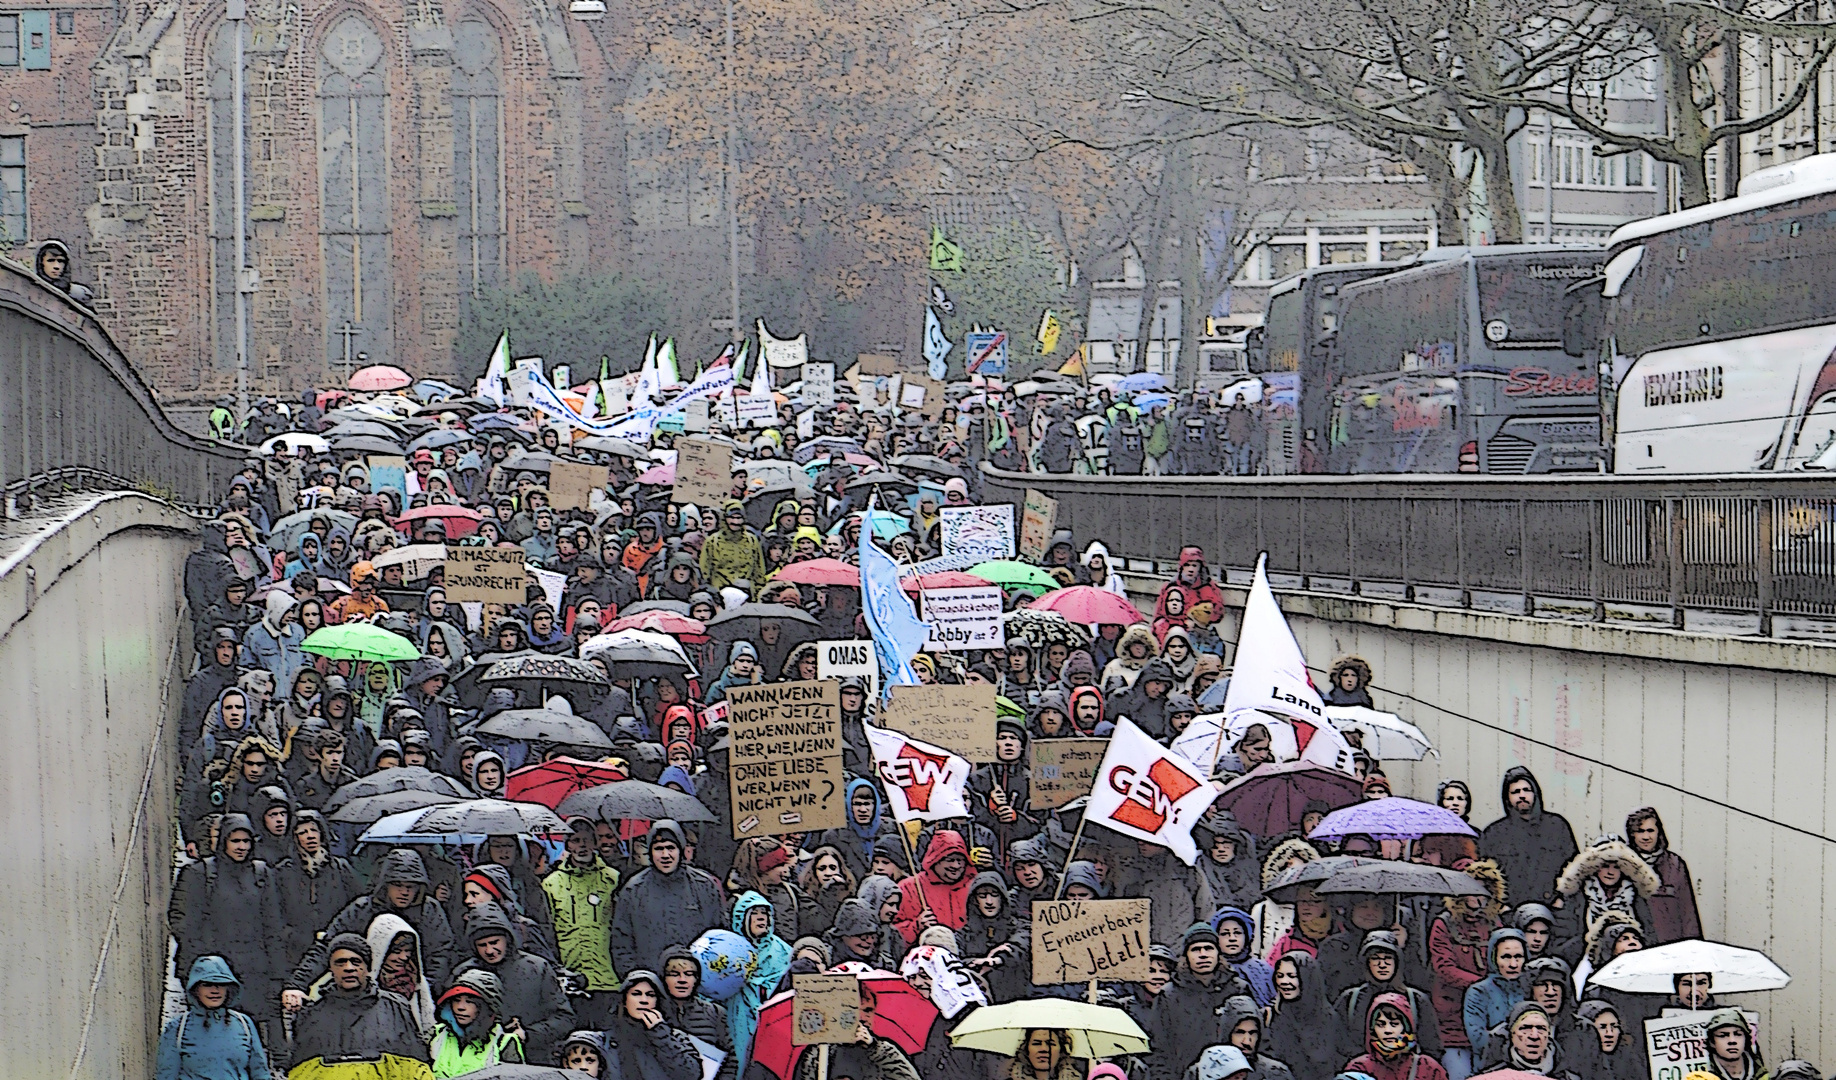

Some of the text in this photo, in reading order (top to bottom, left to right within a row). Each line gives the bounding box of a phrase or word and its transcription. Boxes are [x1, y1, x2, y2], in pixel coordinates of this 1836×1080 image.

[447, 550, 524, 565] KLIMASCHUTZ
[929, 627, 972, 644] Lobby
[828, 645, 868, 665] OMAS
[732, 706, 779, 723] NICHT
[781, 703, 836, 719] JETZT
[735, 762, 778, 781] OHNE
[879, 757, 953, 788] GEW
[738, 797, 786, 812] NICHT
[790, 793, 817, 808] WIR
[1109, 765, 1182, 824] GEW
[1038, 902, 1087, 926] 100%
[1041, 913, 1144, 952] Erneuerbare
[1087, 930, 1145, 975] Jetzt!
[1667, 1039, 1706, 1062] STR
